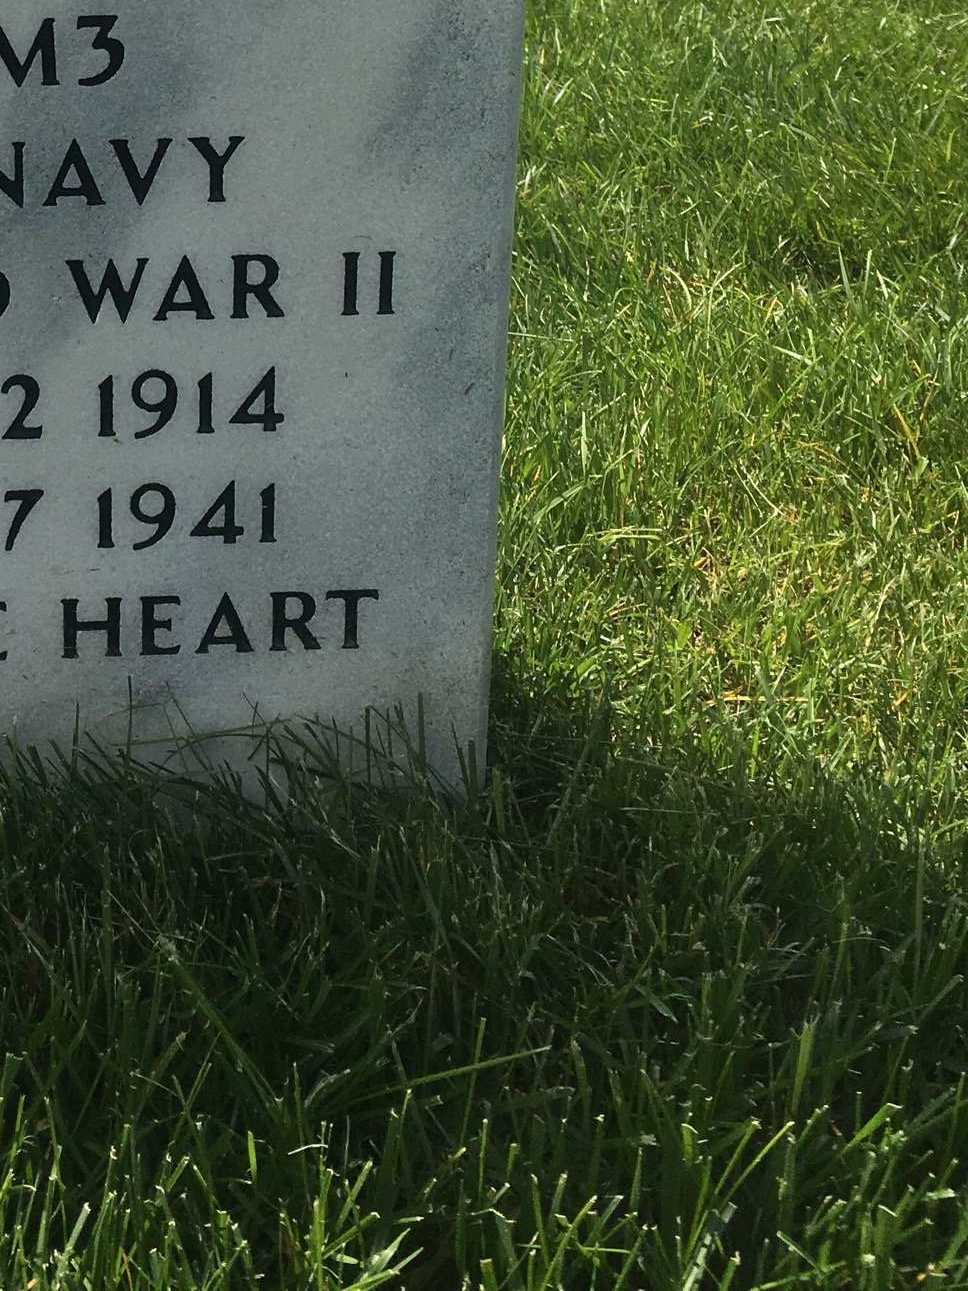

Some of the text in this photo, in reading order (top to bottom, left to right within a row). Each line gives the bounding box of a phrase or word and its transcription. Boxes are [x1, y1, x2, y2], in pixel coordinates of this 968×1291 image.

[65, 253, 285, 324] WAR
[341, 251, 396, 316] II
[1, 374, 43, 440] 2
[98, 365, 284, 439] 1914
[4, 489, 44, 551] 7
[97, 480, 277, 551] 1941
[60, 587, 380, 659] HEART
